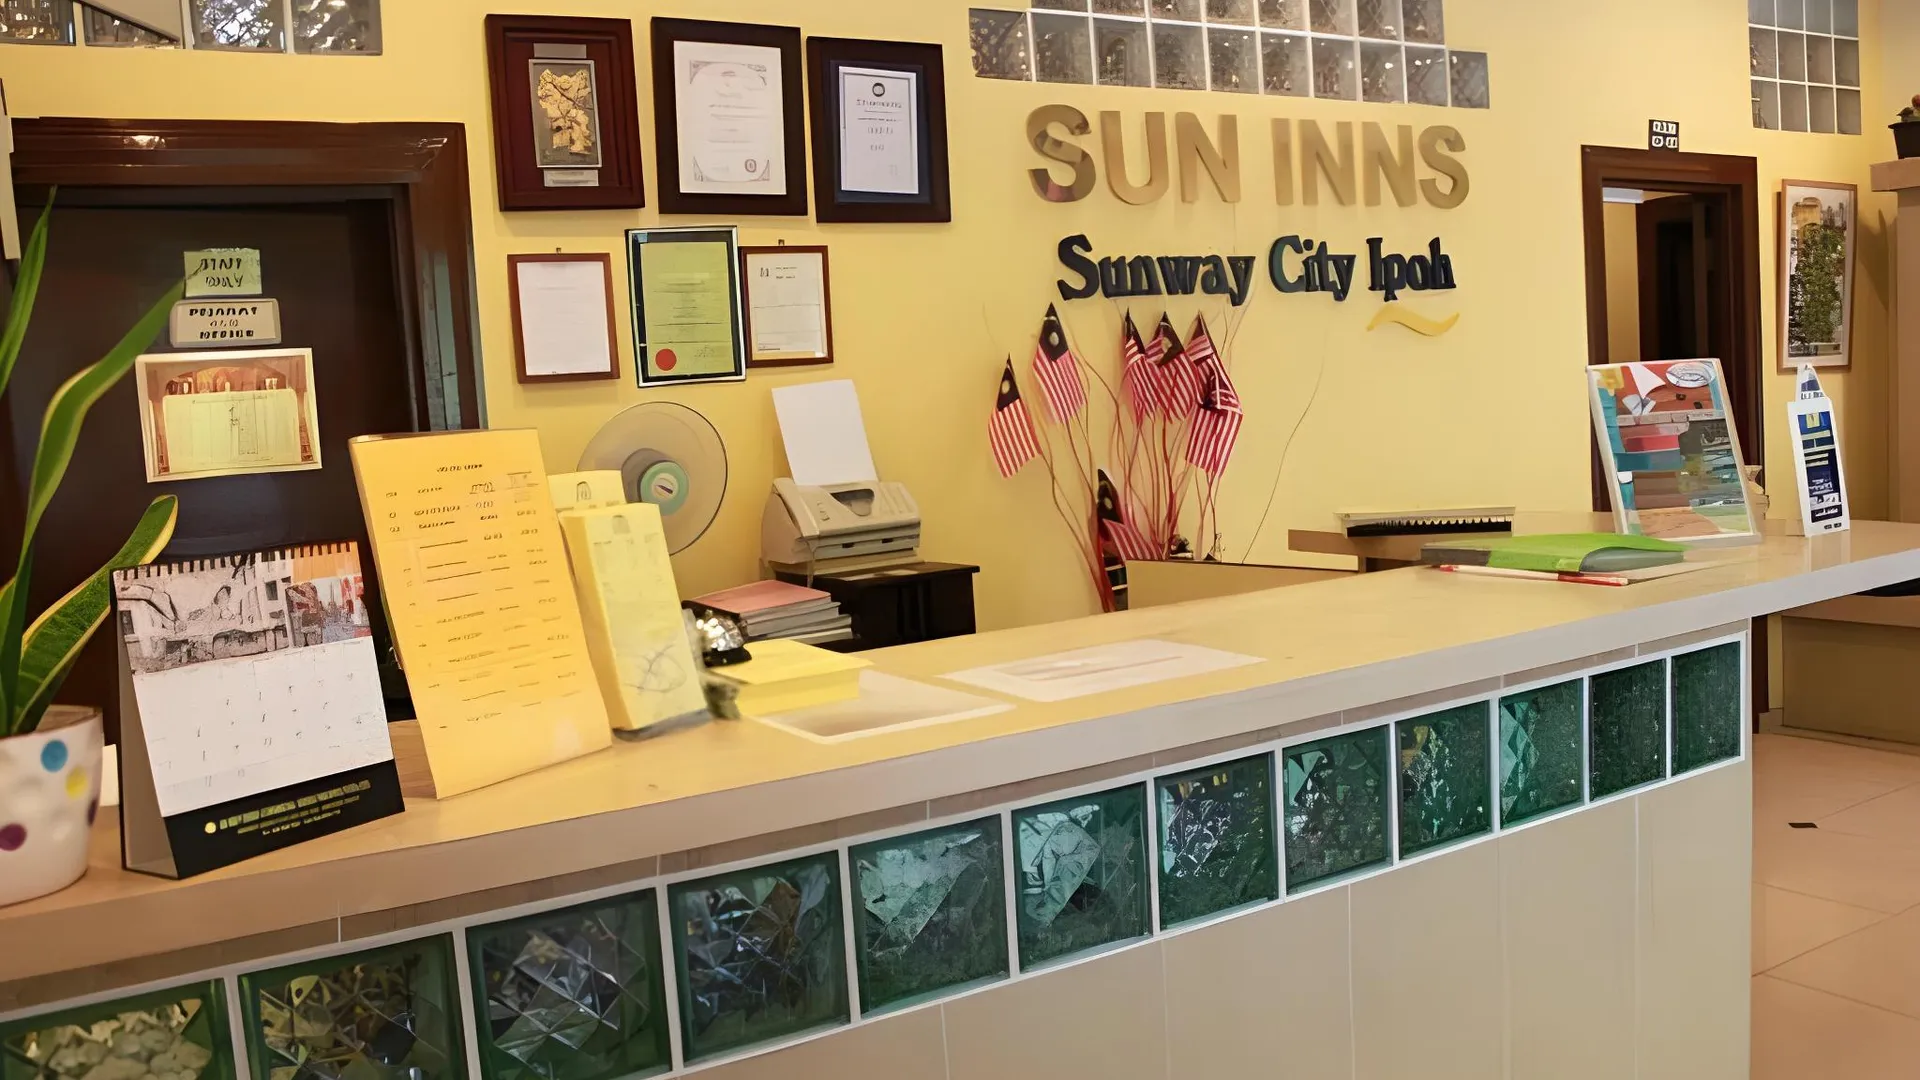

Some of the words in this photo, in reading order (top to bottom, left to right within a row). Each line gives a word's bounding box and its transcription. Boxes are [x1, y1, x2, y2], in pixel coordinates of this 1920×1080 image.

[1026, 104, 1240, 205] SUN
[1271, 117, 1470, 209] INNS
[1057, 234, 1256, 306] Sunway
[1268, 235, 1356, 302] City
[1366, 236, 1457, 301] Ipoh
